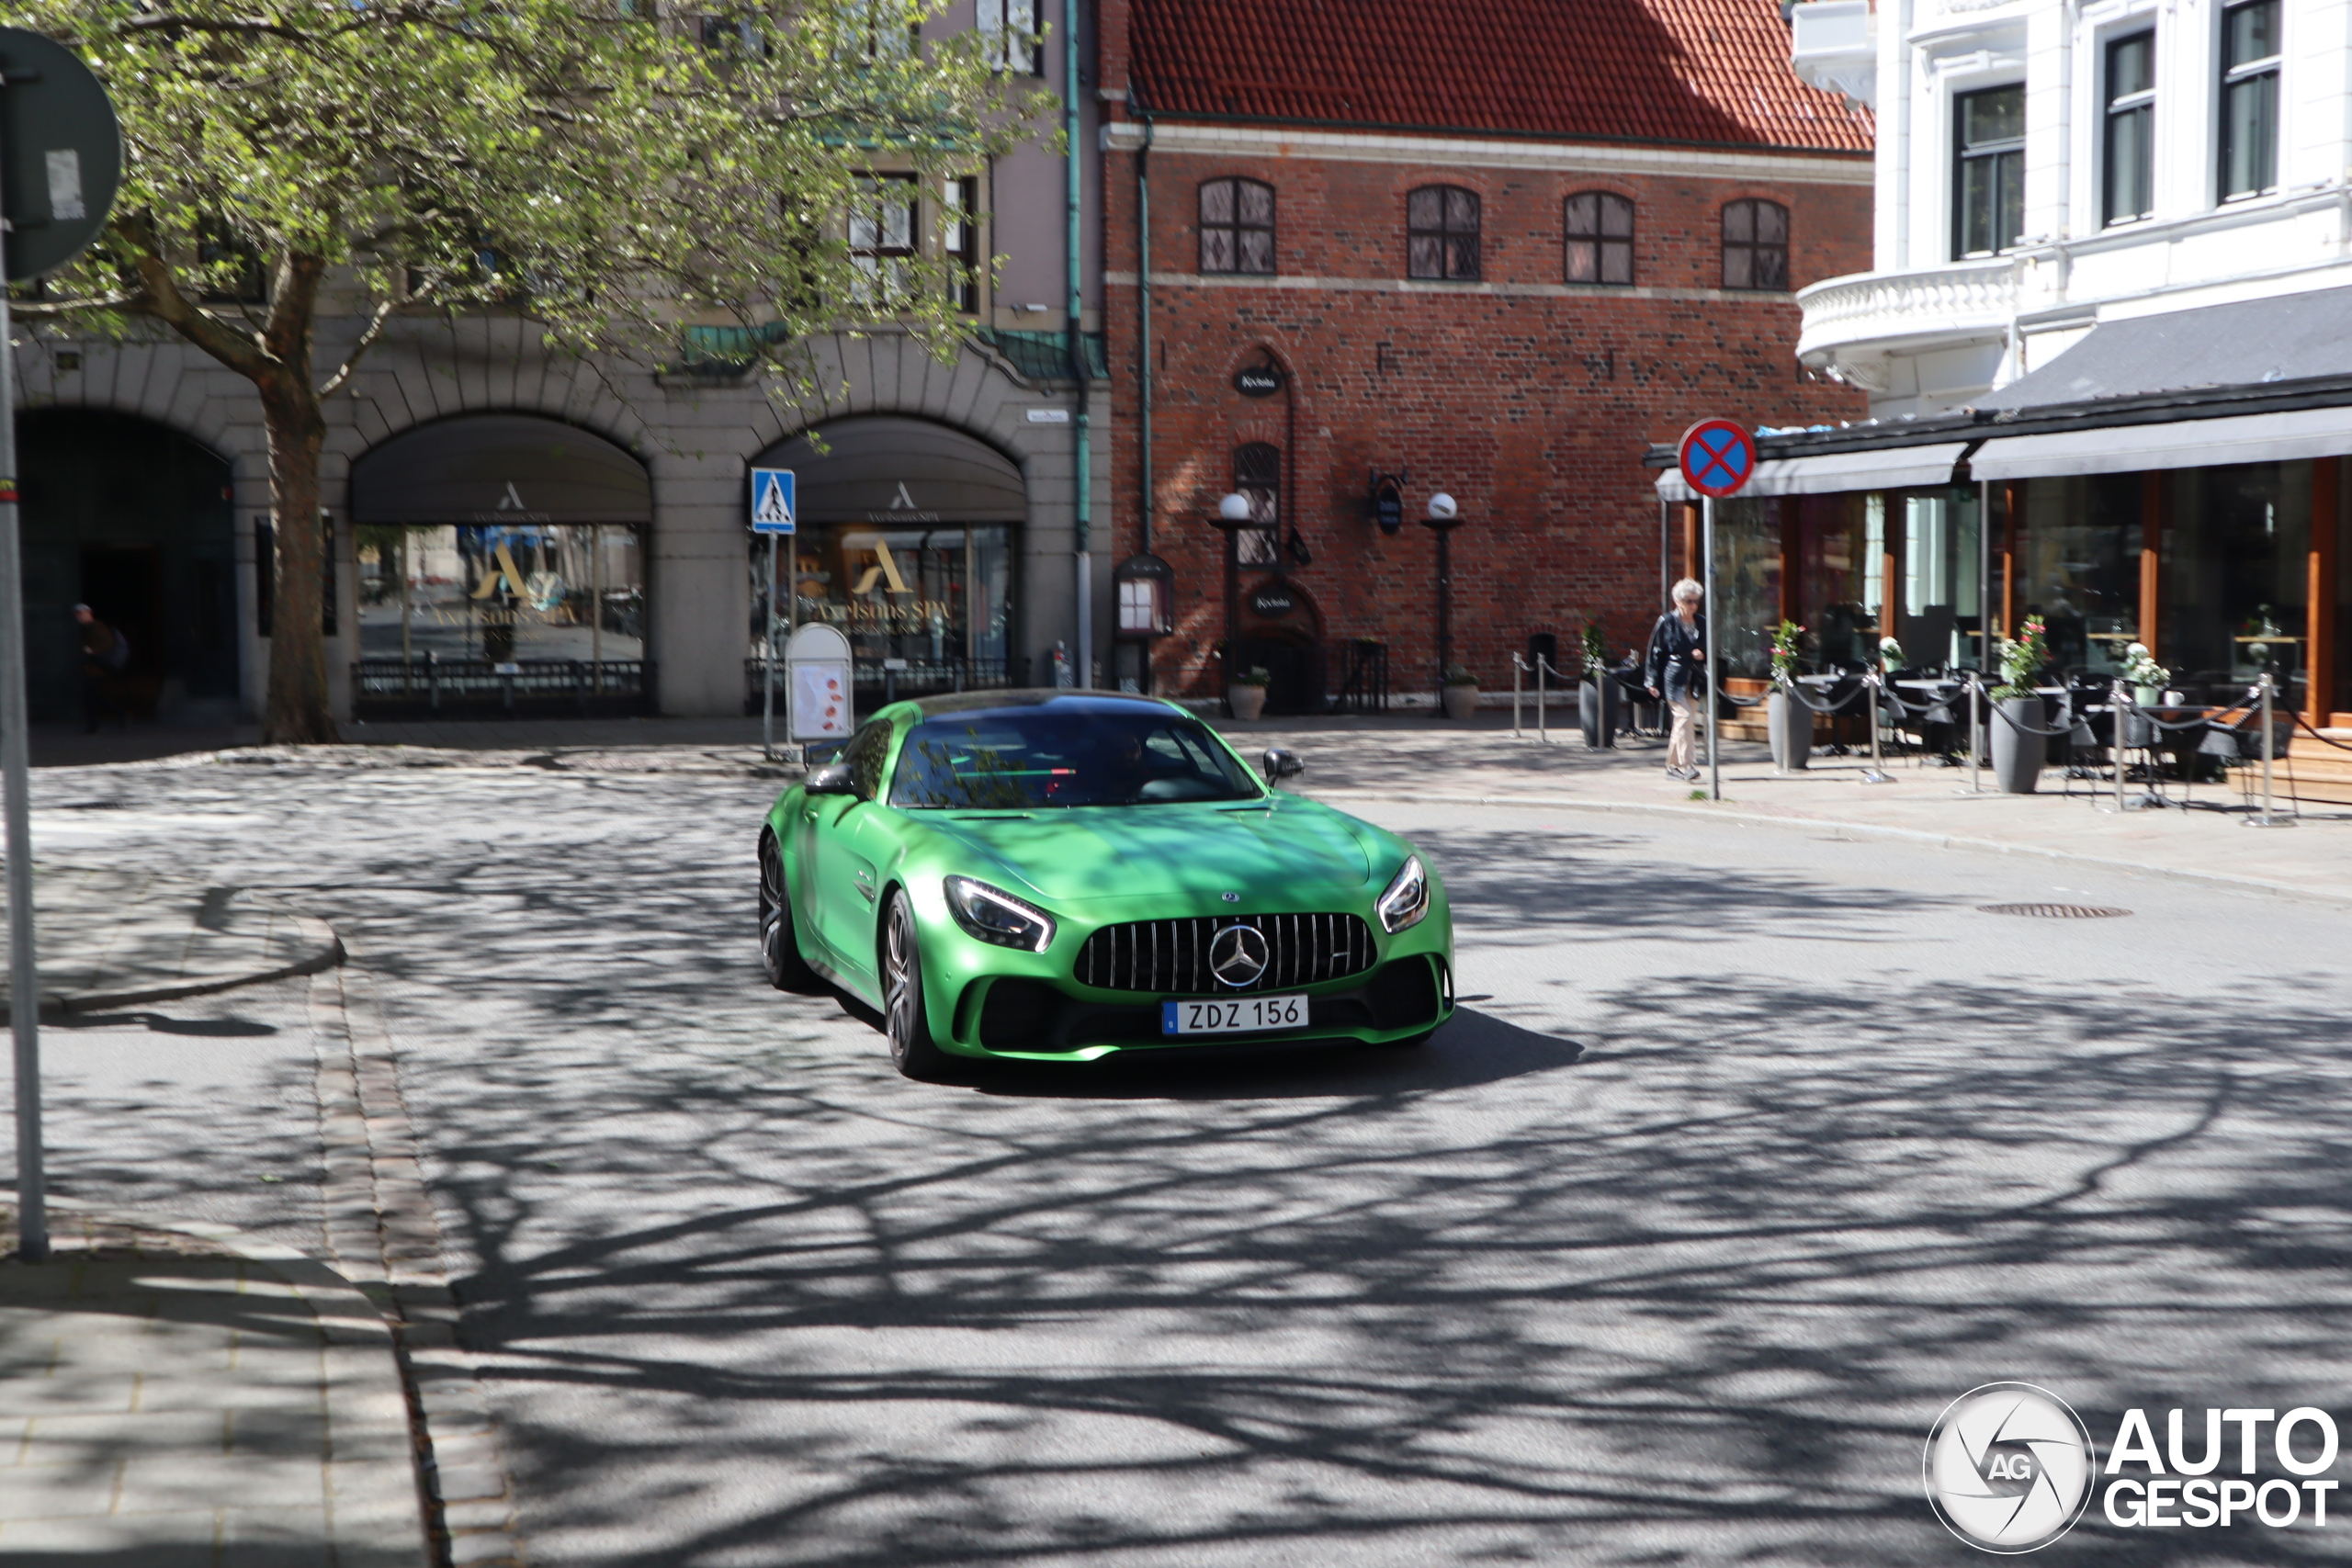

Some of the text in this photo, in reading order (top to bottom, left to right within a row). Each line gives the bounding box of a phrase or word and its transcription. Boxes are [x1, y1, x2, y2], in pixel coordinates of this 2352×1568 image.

[911, 600, 950, 620] SPA
[1189, 1003, 1240, 1030] ZDZ
[1252, 998, 1299, 1026] 156
